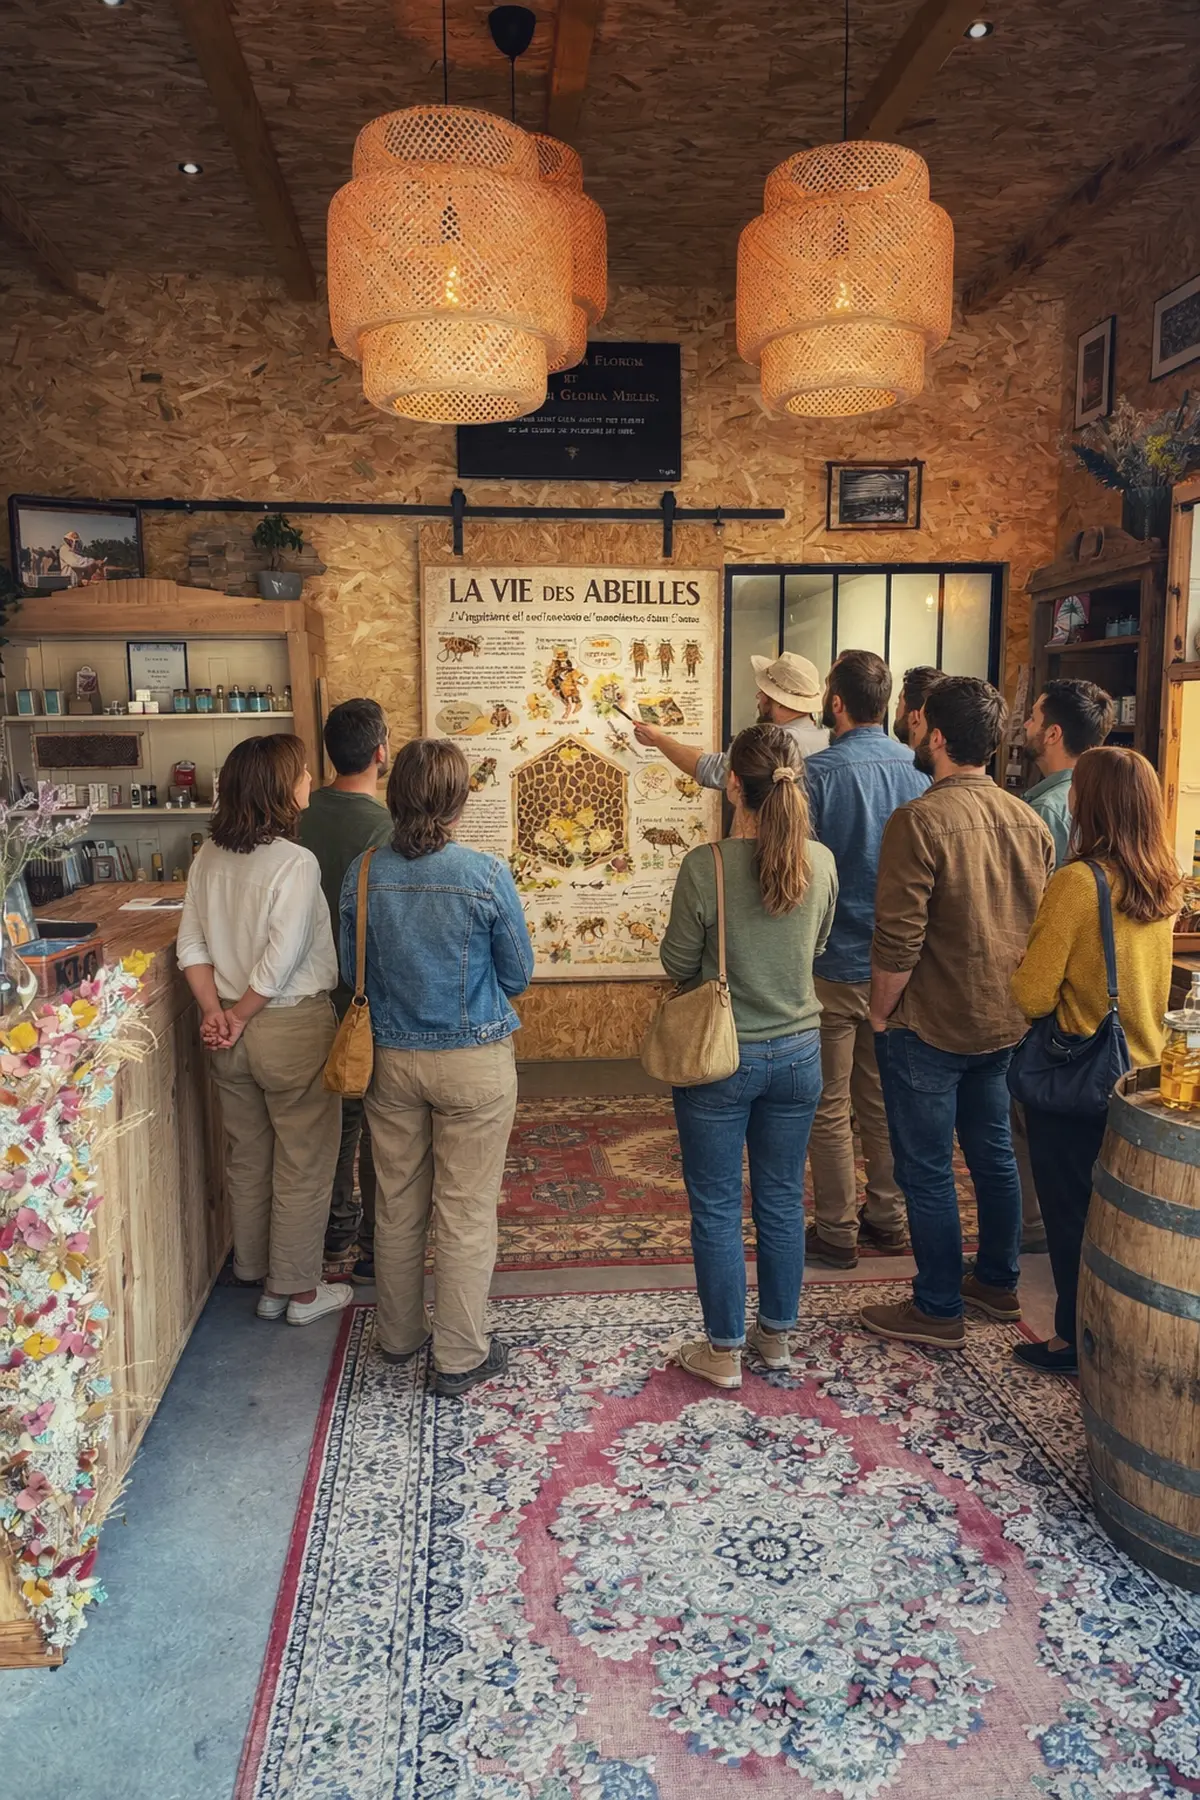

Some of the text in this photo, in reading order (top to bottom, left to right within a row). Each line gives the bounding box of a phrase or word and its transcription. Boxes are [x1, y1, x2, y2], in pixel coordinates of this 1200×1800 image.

[449, 578, 701, 606] LA VIE DES ABEILLES
